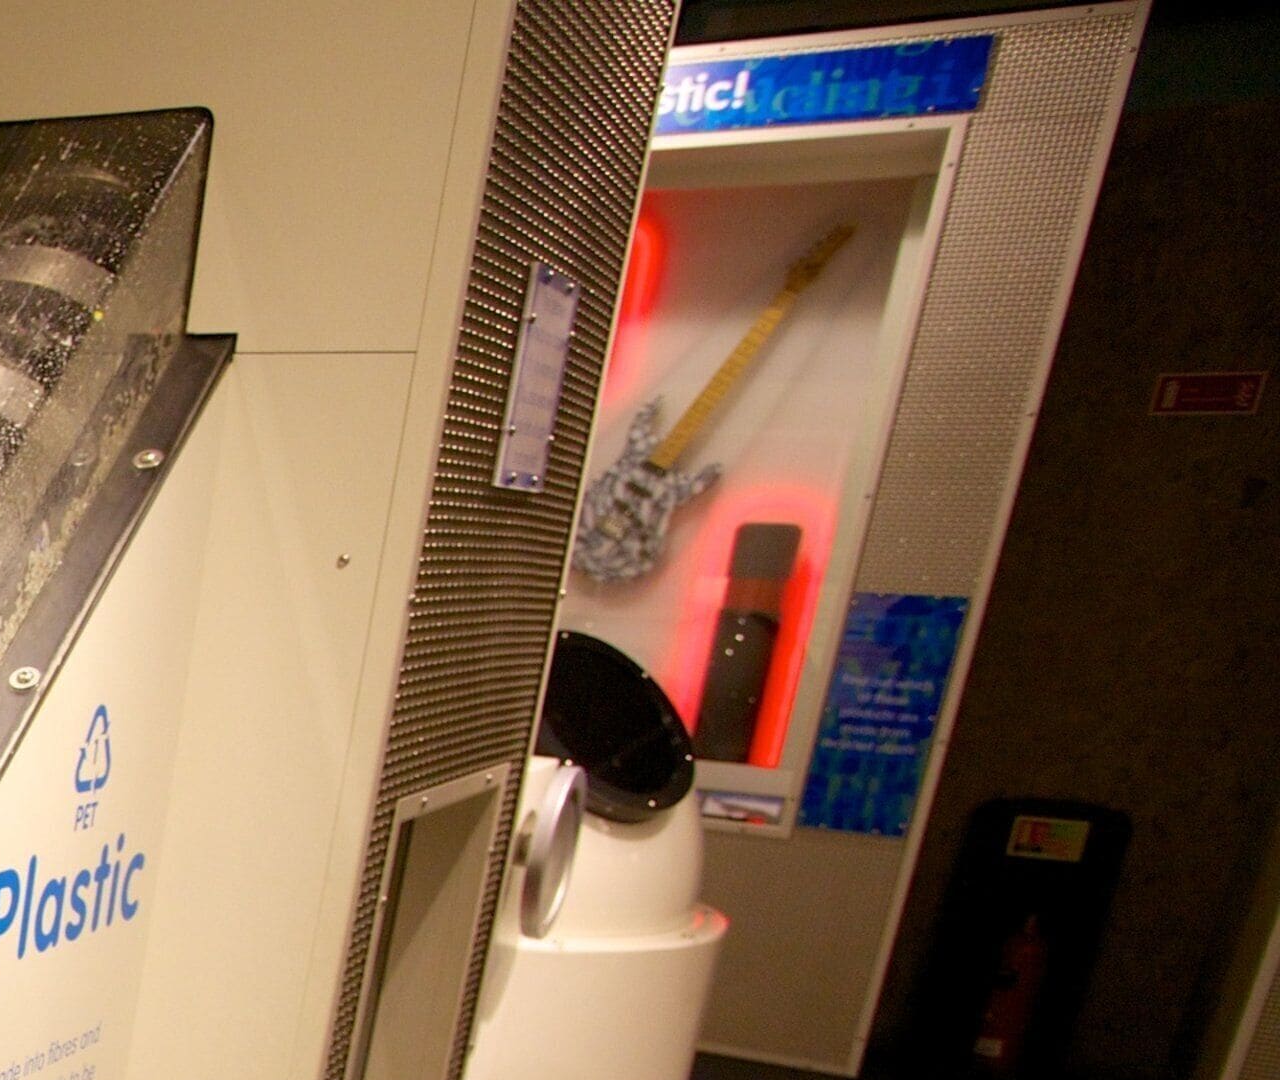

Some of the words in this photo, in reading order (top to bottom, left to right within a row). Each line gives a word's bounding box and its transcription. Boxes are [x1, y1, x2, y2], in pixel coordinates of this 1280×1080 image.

[74, 802, 98, 831] PET
[24, 1051, 45, 1077] into
[47, 1037, 79, 1065] fibres
[79, 1022, 102, 1050] and
